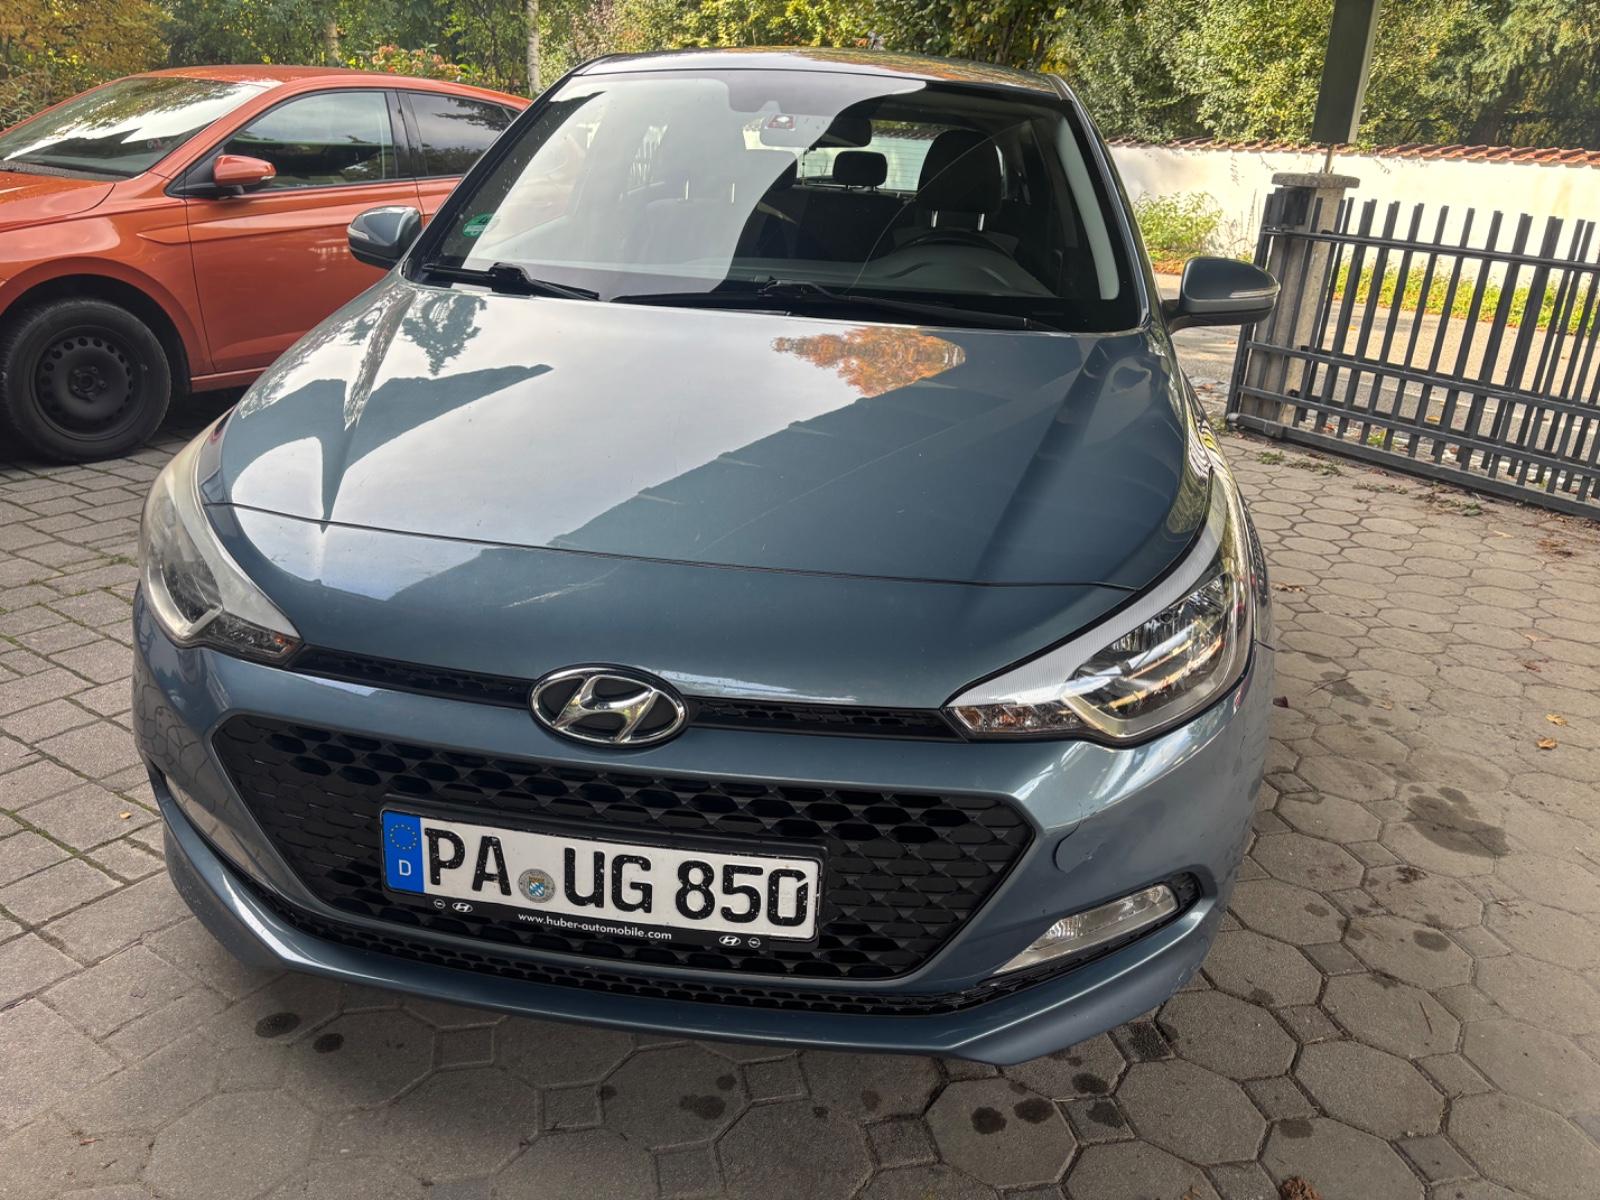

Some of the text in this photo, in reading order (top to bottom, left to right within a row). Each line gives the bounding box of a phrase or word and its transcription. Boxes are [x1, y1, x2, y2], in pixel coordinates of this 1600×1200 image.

[398, 860, 412, 876] D
[424, 827, 513, 896] PA
[564, 847, 653, 914] UG
[675, 860, 809, 926] 850
[517, 912, 673, 941] www.huber-automobile.com
